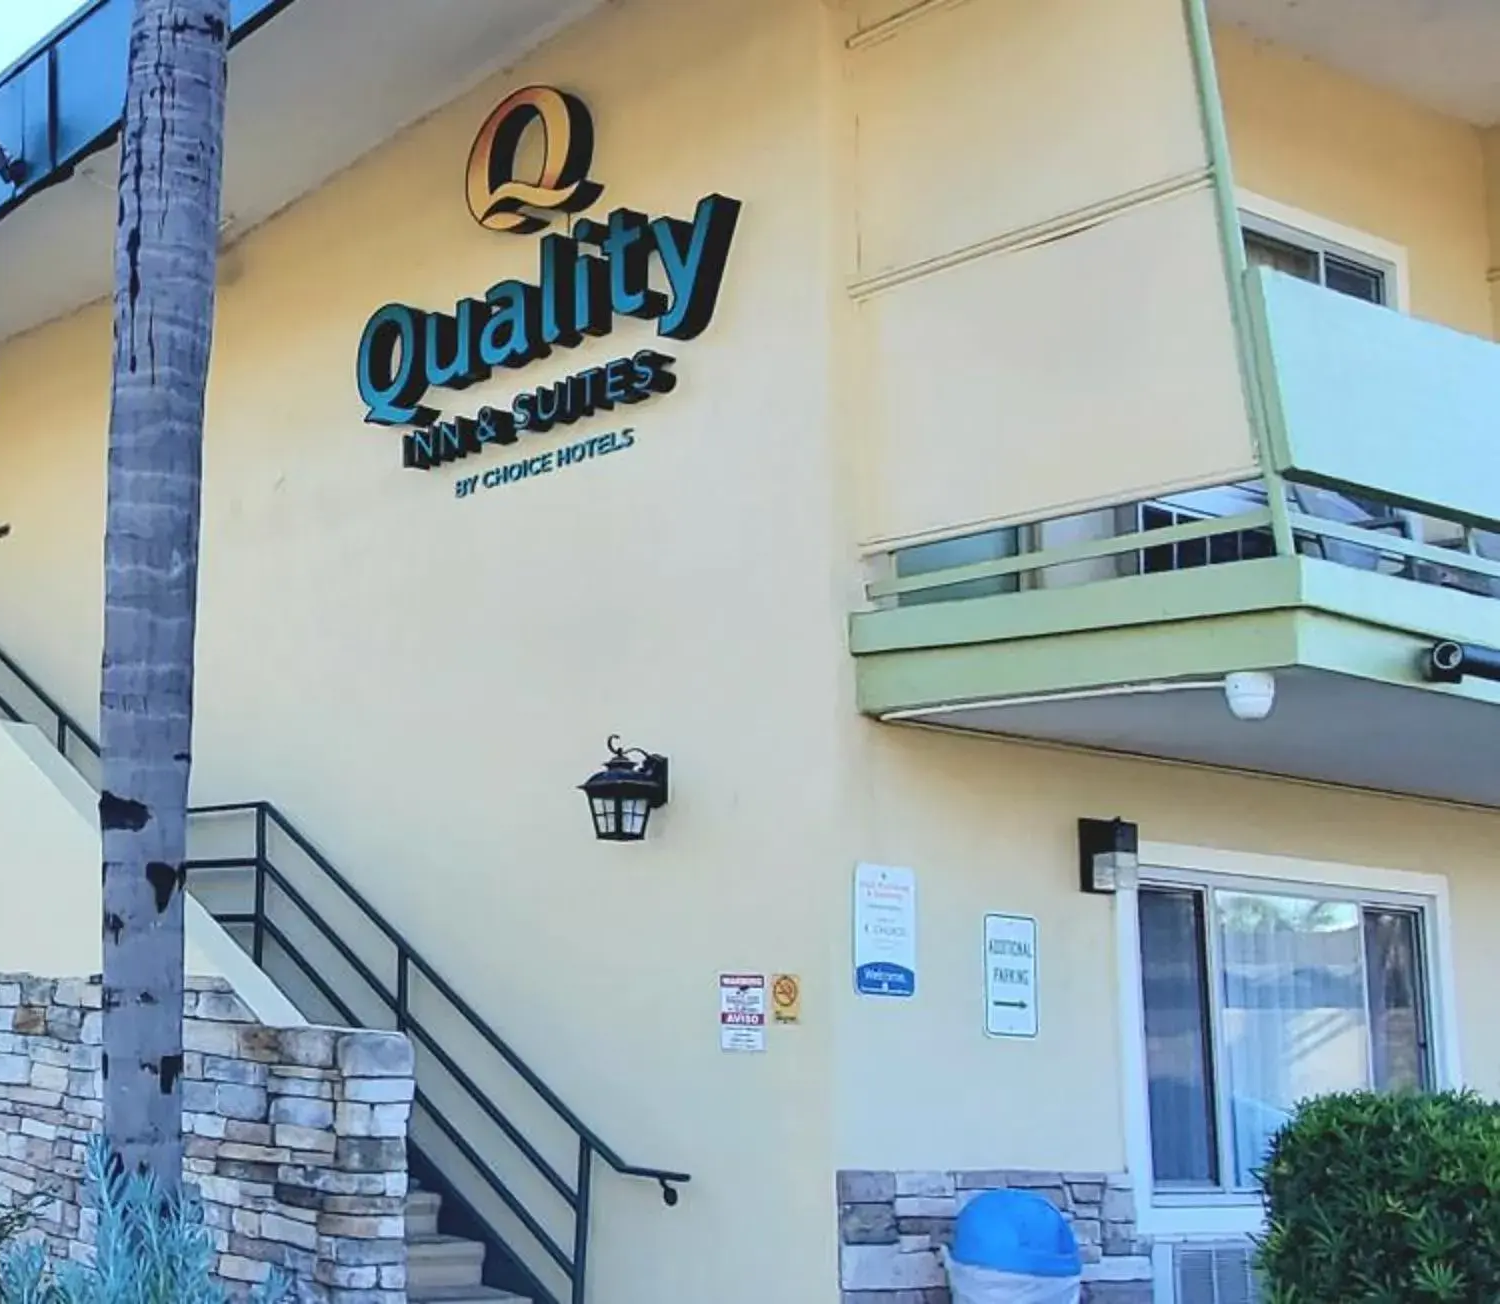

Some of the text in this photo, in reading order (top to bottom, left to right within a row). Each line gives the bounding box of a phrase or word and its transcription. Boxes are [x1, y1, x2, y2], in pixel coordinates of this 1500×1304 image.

[356, 192, 742, 428] Quality
[474, 405, 518, 446] &
[510, 349, 677, 433] SUITES
[455, 428, 636, 499] BY CHOICE HOTELS
[993, 966, 1030, 986] PARKING
[726, 1013, 759, 1024] AVISO
